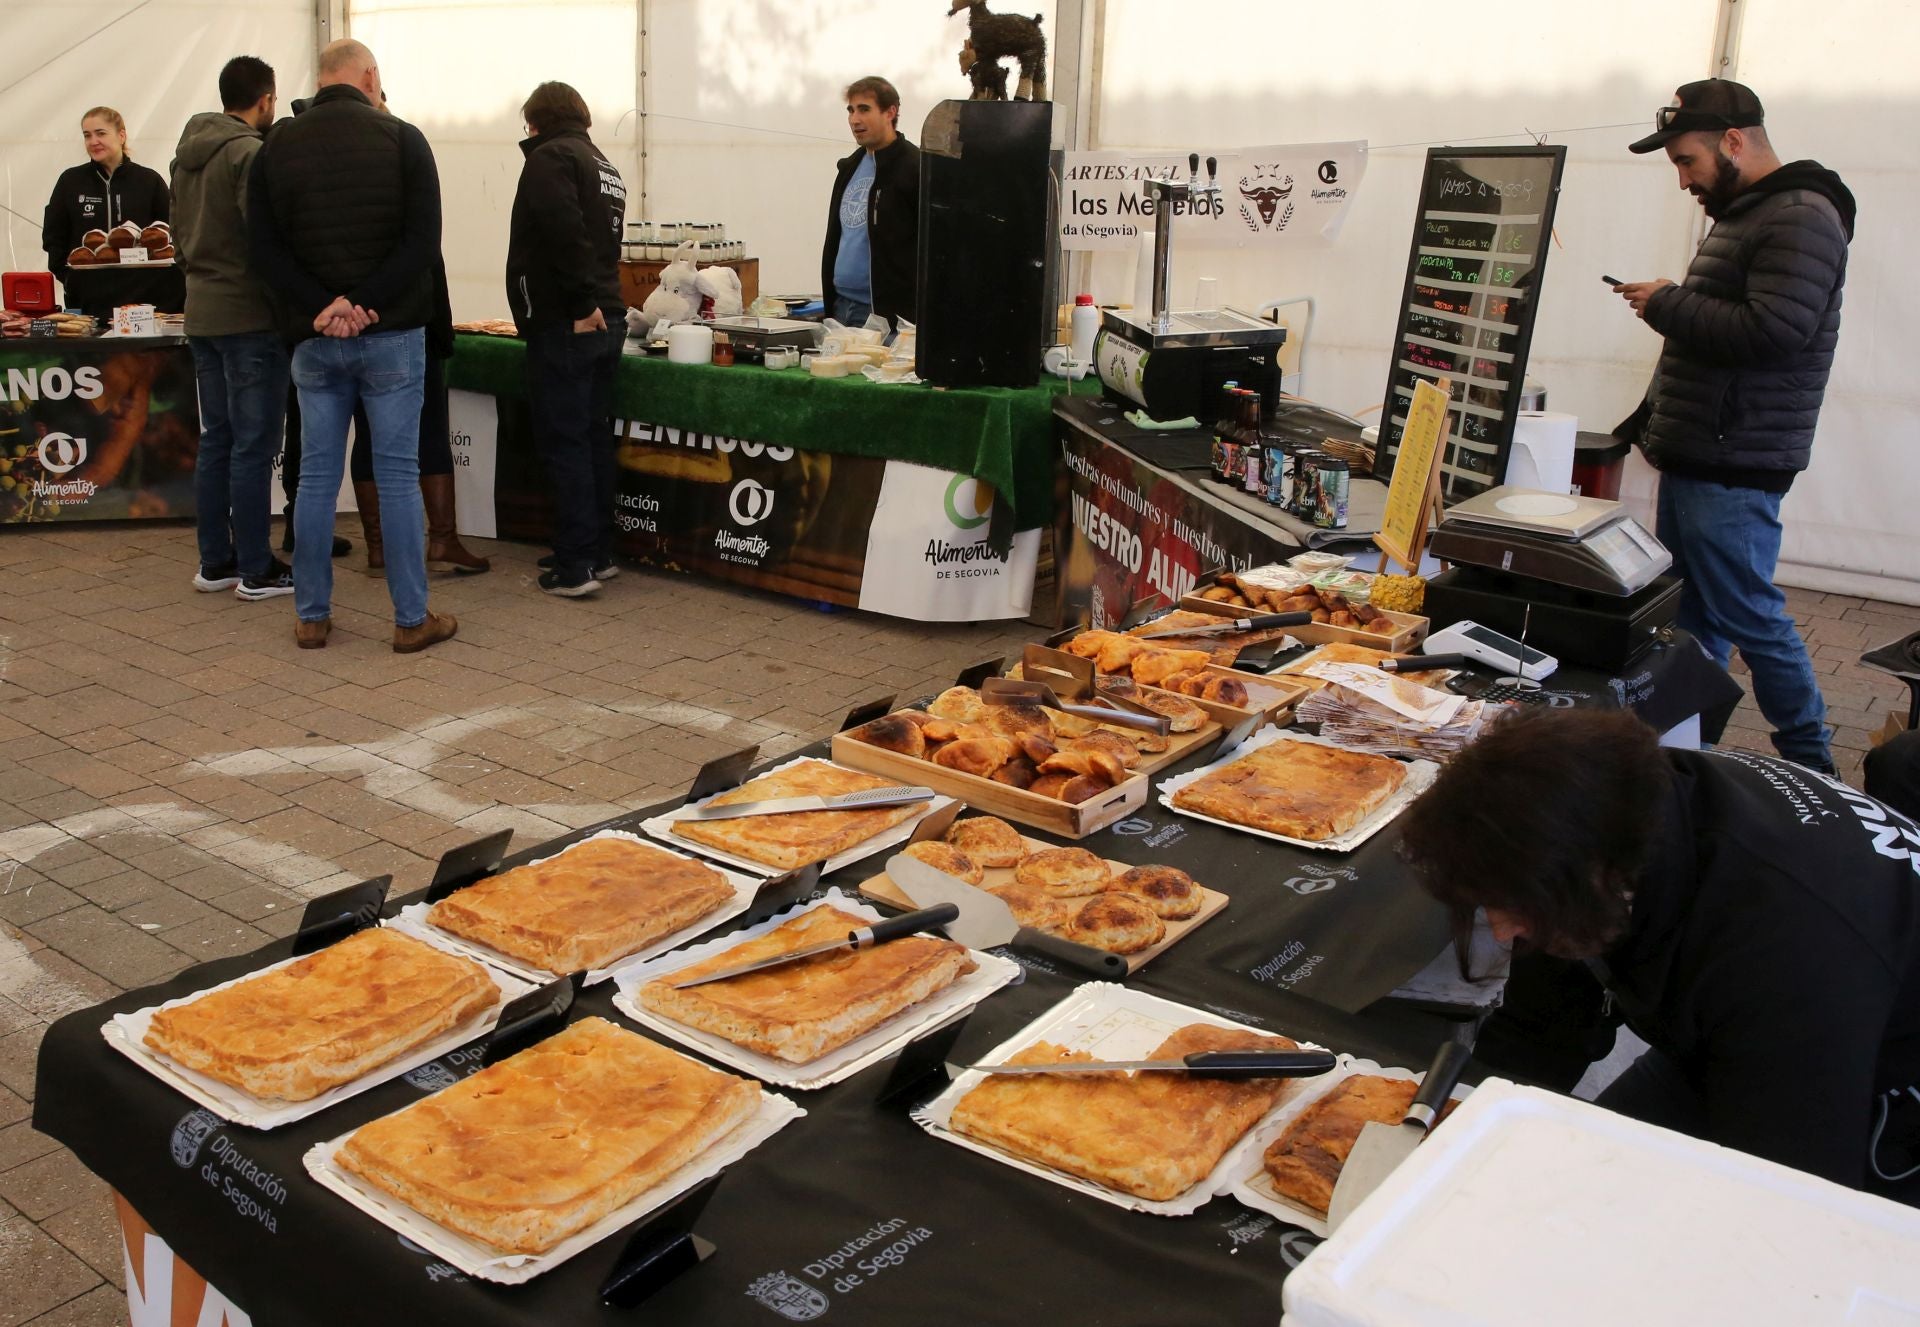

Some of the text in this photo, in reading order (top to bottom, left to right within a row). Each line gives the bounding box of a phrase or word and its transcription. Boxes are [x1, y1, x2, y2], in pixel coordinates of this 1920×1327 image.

[1072, 189, 1108, 216] las
[1081, 223, 1138, 239] (Segovia)
[0, 366, 104, 401] NOS
[32, 478, 98, 497] Alimentos
[1071, 488, 1143, 574] NUESTRO
[1101, 471, 1161, 526] costumbres
[1162, 511, 1170, 538] y
[1173, 517, 1227, 568] nuestros
[714, 529, 770, 557] Alimentos
[720, 552, 759, 566] DE SEGOVIA
[936, 568, 1000, 579] DE SEGOVIA
[1250, 940, 1306, 982] Diputación
[1281, 955, 1326, 985] Segovia
[210, 1134, 288, 1205] Diputación
[201, 1161, 277, 1234] de Segovia
[802, 1216, 908, 1280] Diputación
[833, 1226, 934, 1294] de Segovia
